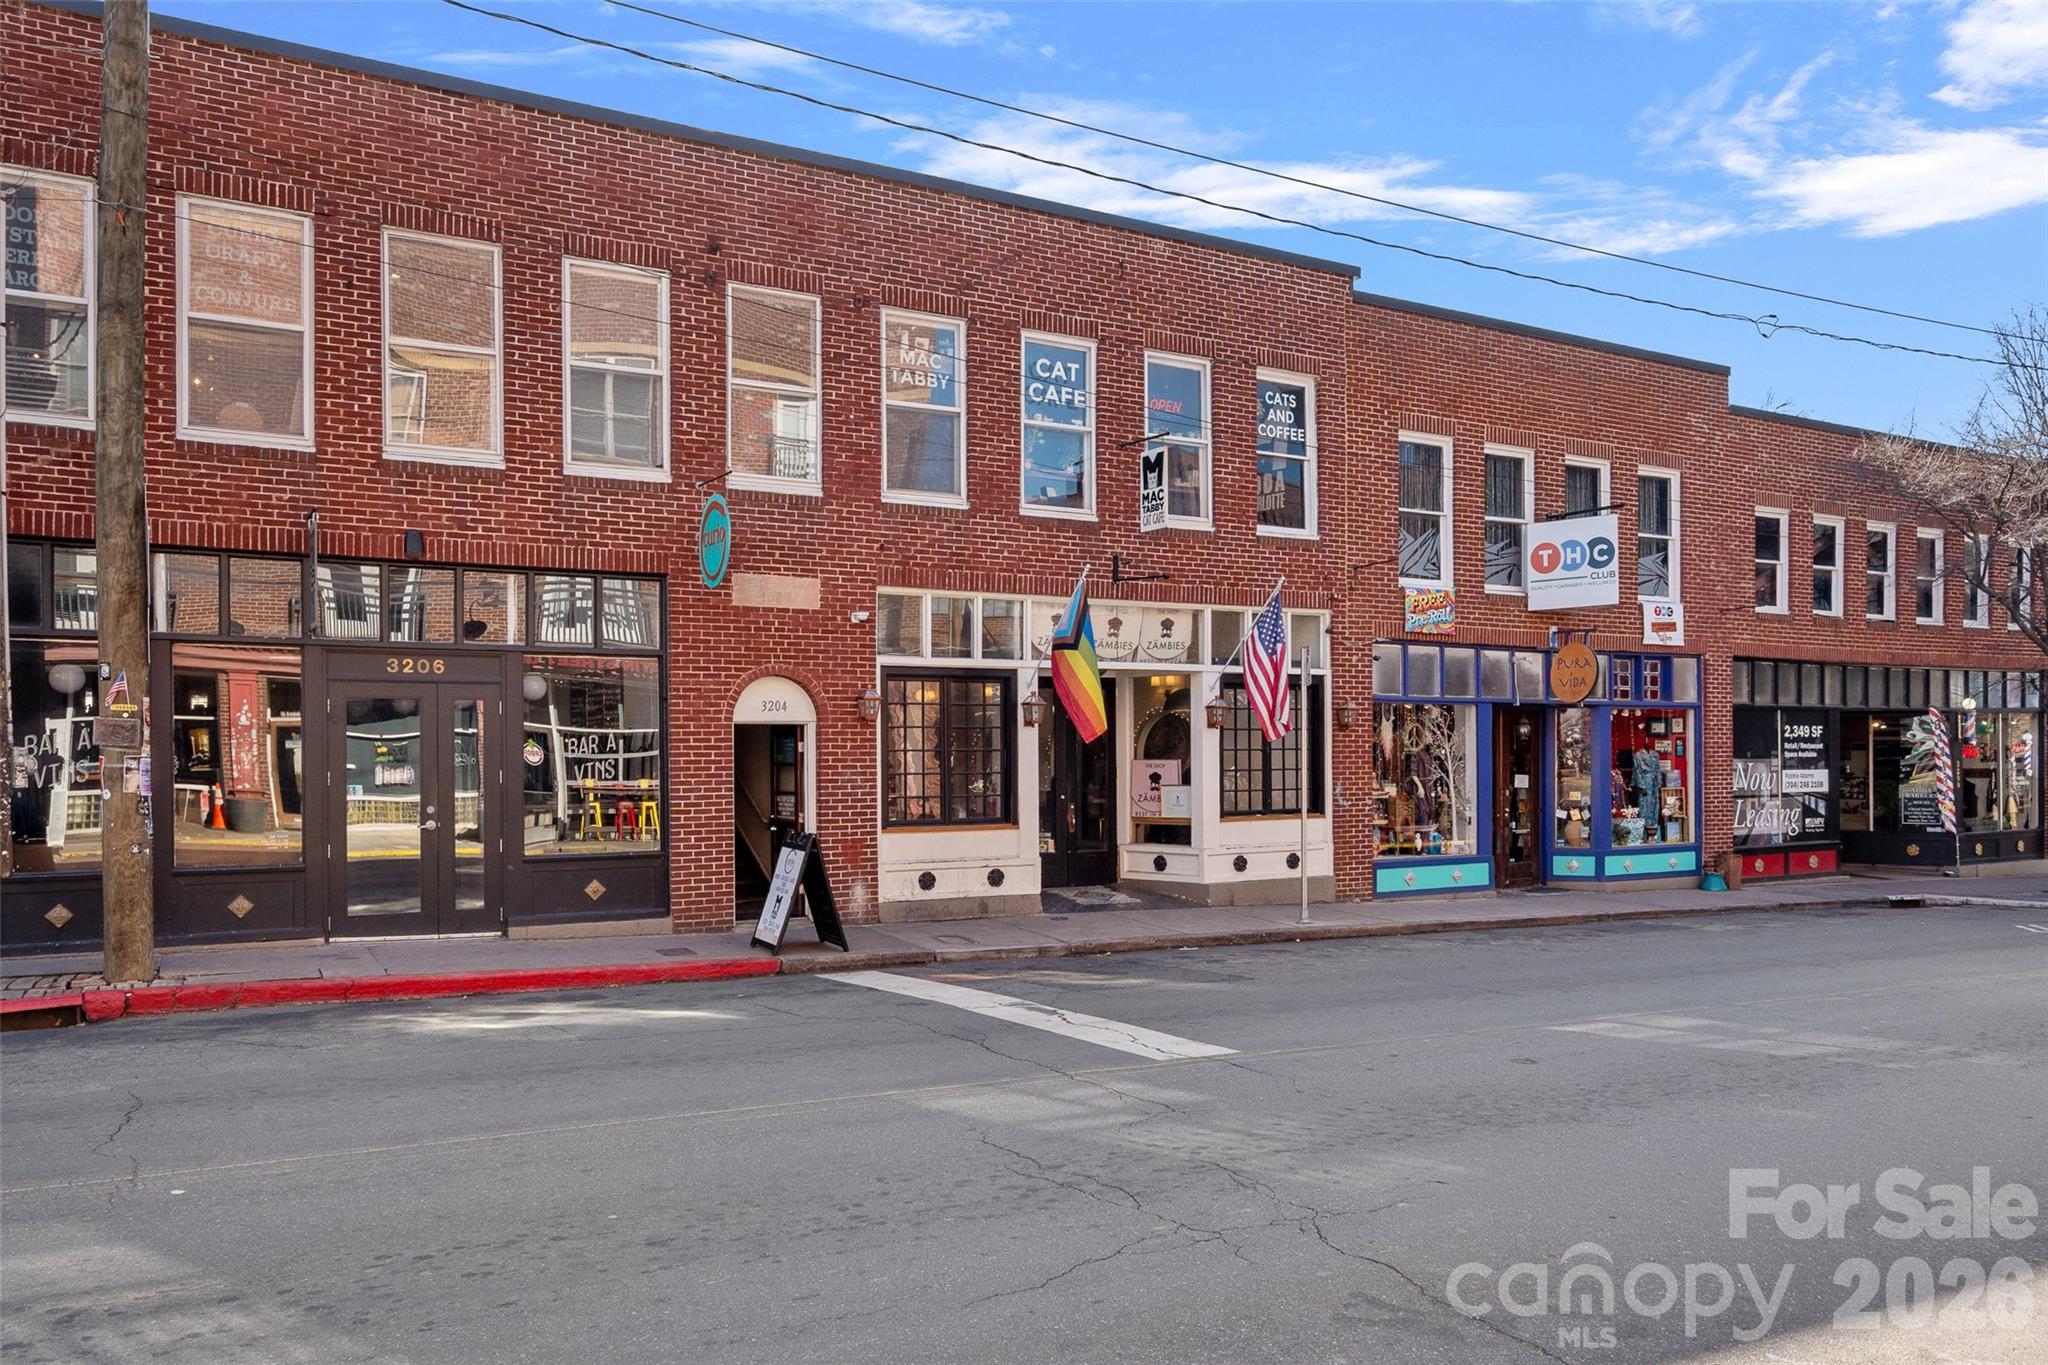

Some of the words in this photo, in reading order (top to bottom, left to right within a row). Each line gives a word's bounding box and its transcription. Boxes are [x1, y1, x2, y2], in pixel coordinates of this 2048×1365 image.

[241, 270, 255, 285] &
[900, 349, 942, 369] MAC
[1036, 358, 1079, 382] CAT
[892, 367, 950, 389] TABBY
[1029, 382, 1086, 408] CAFE
[1265, 391, 1296, 408] CATS
[1150, 399, 1182, 413] OPEN
[1267, 408, 1294, 423] AND
[1258, 423, 1305, 441] COFFEE
[1142, 489, 1164, 505] MAC
[1142, 502, 1164, 514] TABBY
[1142, 514, 1151, 526] CAT
[1152, 511, 1165, 524] CAFE
[1537, 543, 1609, 567] THC
[1590, 571, 1616, 579] CLUB
[1410, 593, 1447, 614] FREE
[1146, 640, 1186, 650] ZÄMBIES
[387, 658, 445, 674] 3206
[1557, 657, 1591, 670] PURA
[1559, 677, 1586, 688] VIDA
[761, 700, 787, 712] 3204
[1784, 725, 1810, 739] 2,349
[1811, 725, 1824, 737] SF
[568, 735, 599, 757] BAR
[1733, 762, 1776, 791] Now
[1785, 781, 1799, 790] (704)
[1138, 792, 1161, 802] ZÄMB
[1733, 800, 1801, 836] Leasing
